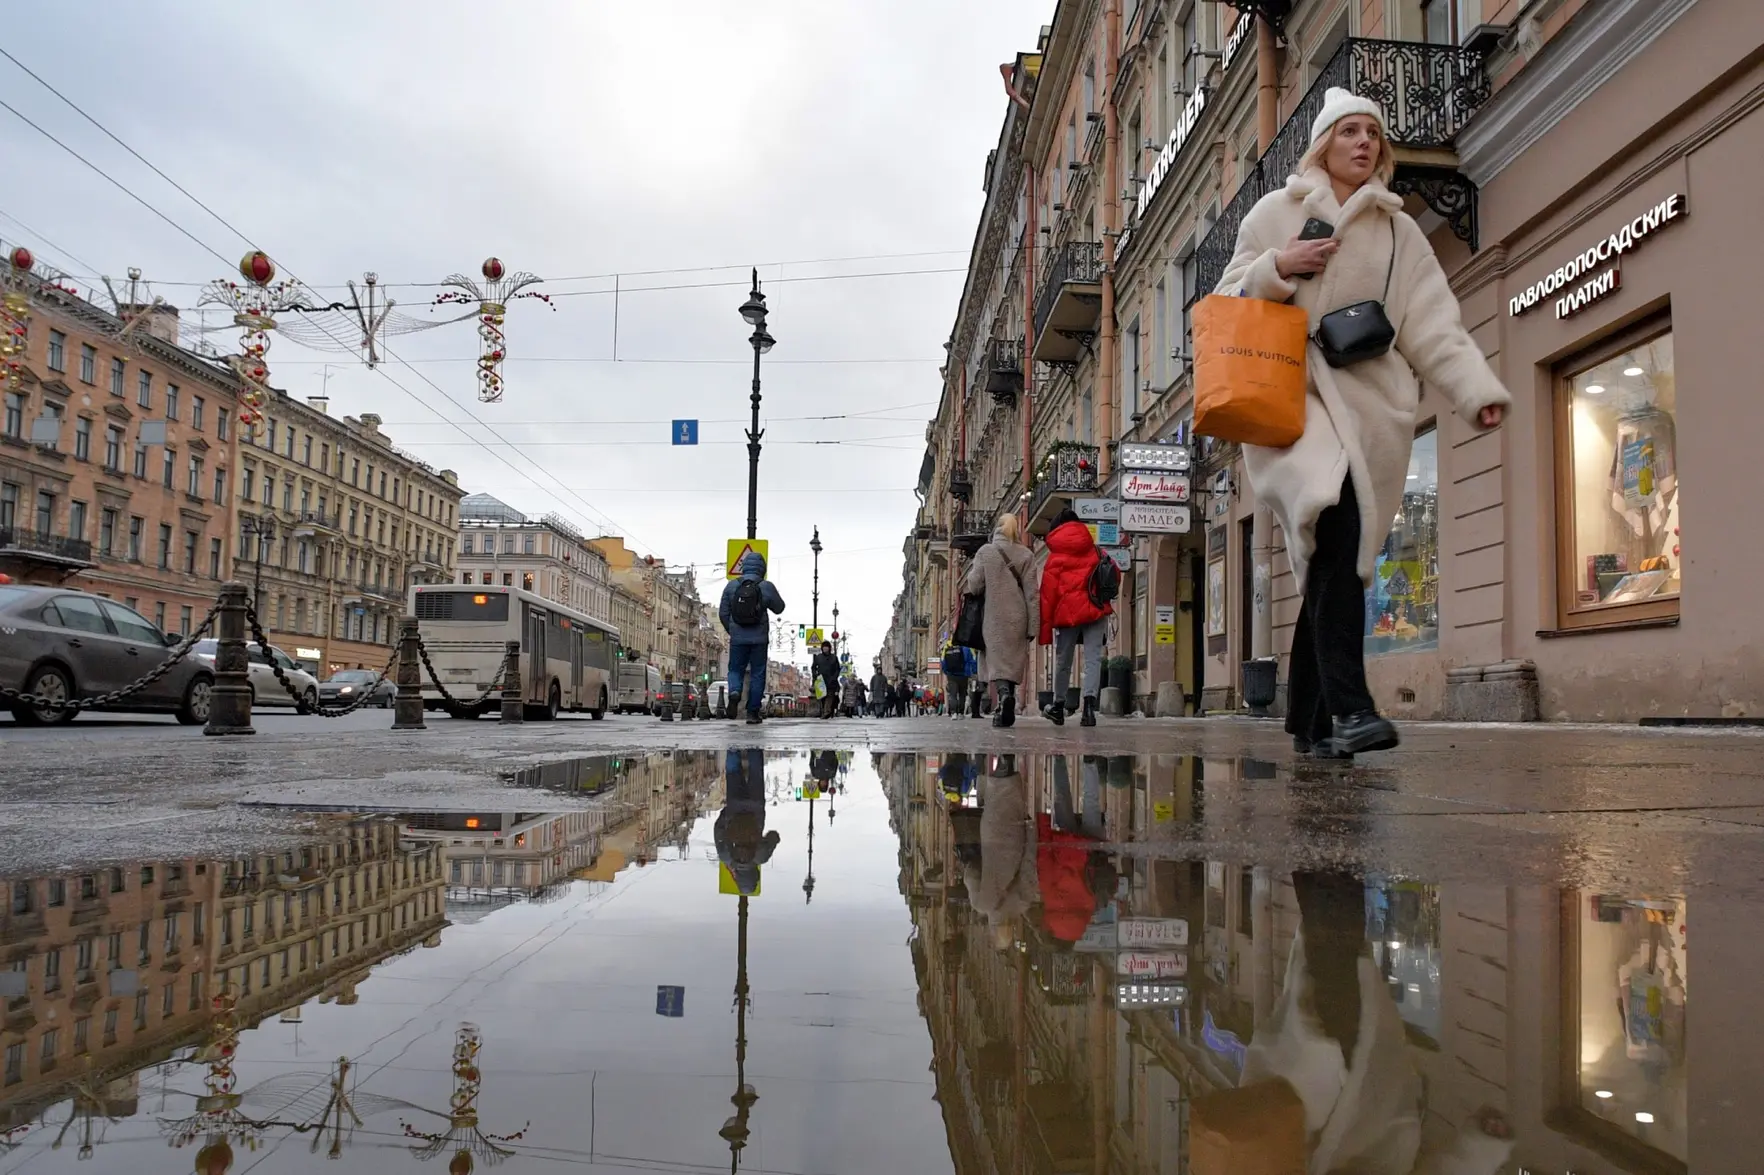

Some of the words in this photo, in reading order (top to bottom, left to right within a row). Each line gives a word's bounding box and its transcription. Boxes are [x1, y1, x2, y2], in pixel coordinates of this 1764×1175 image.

[1509, 193, 1678, 316] ПАВЛОВОПОСАДСКИЕ
[1555, 268, 1614, 320] ПЛАТКИ
[1220, 346, 1253, 357] LOUIS
[1256, 350, 1300, 367] VUITTON
[1127, 475, 1152, 497] Арт
[1154, 476, 1186, 499] Лайф
